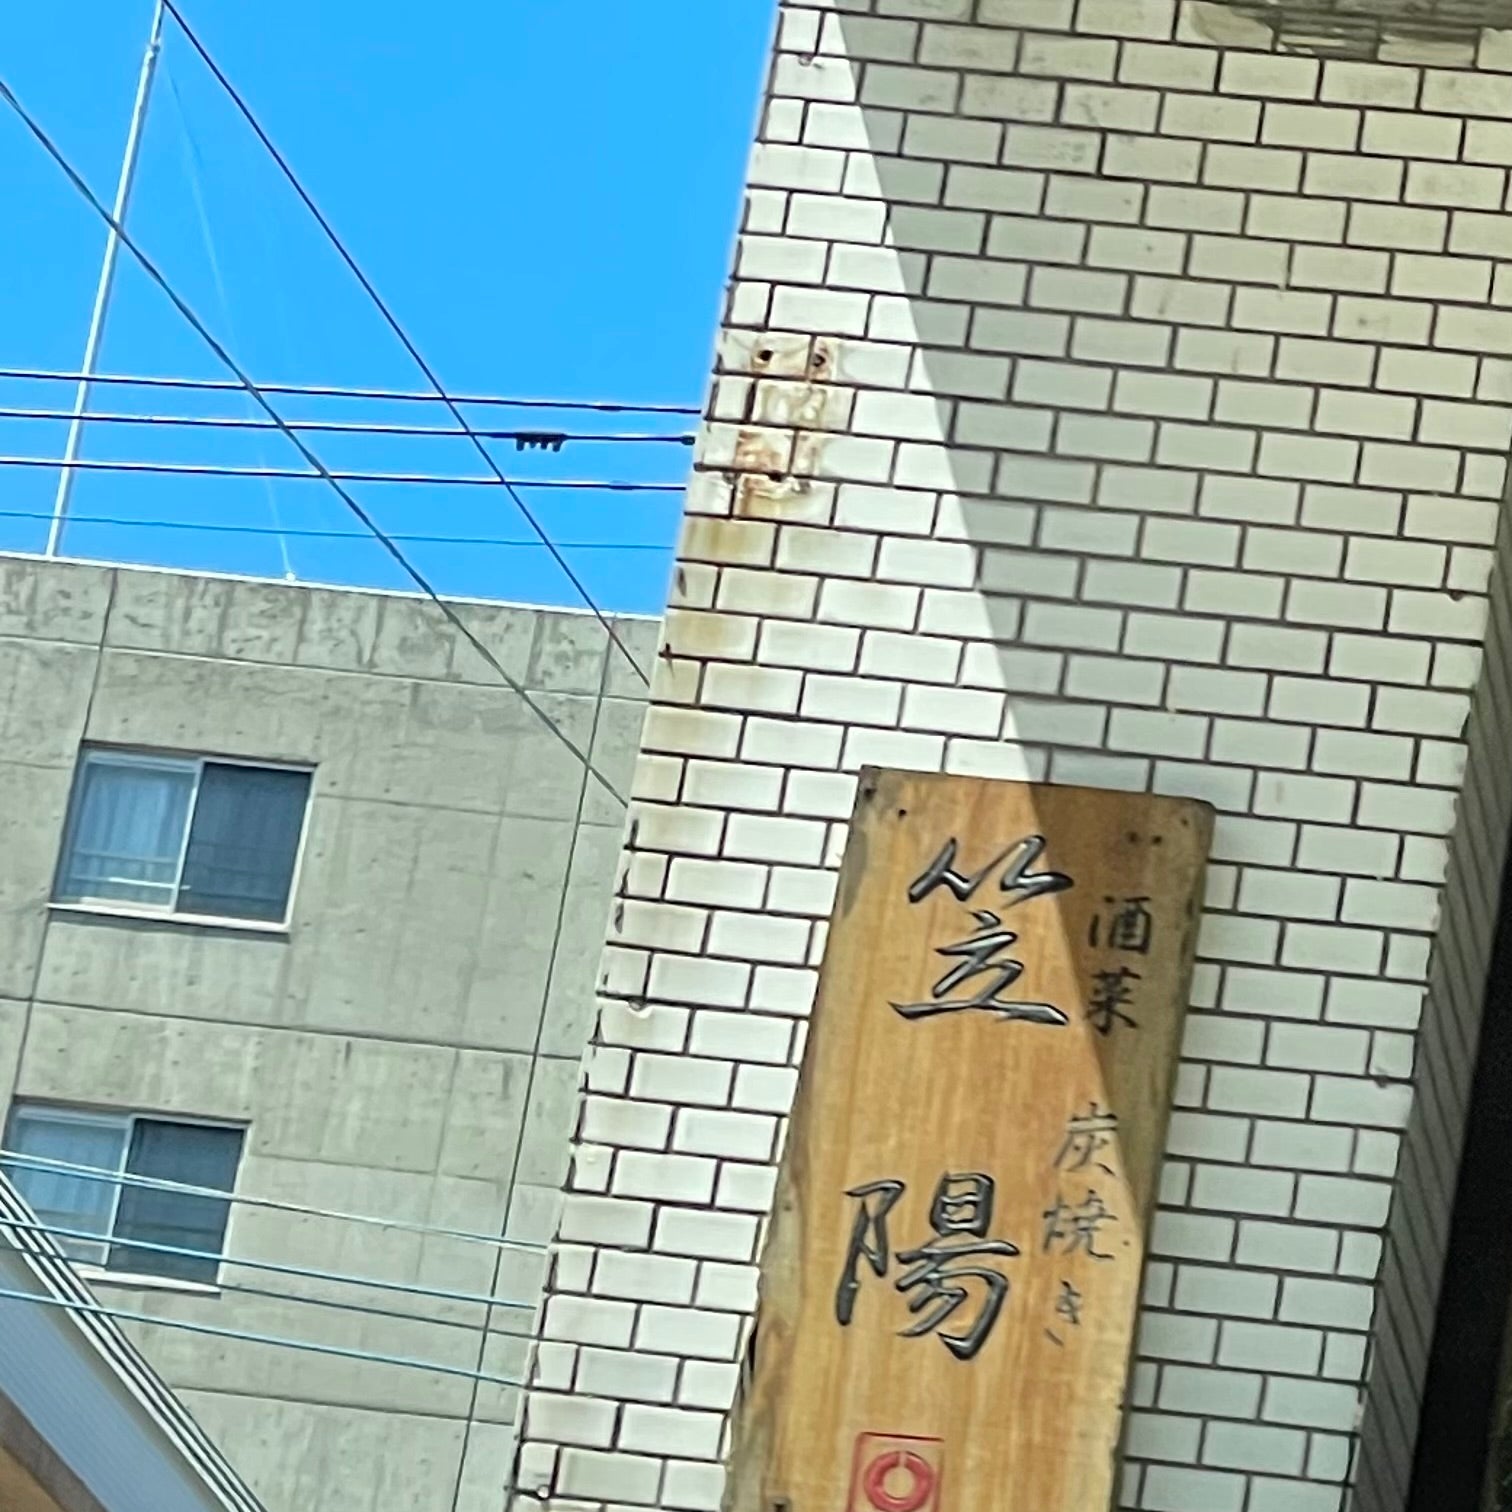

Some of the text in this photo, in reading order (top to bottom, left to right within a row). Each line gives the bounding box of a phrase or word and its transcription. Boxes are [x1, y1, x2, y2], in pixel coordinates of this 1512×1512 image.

[836, 833, 1074, 1361] 笠陽
[1042, 896, 1152, 1347] 酒菜 炭焼き
